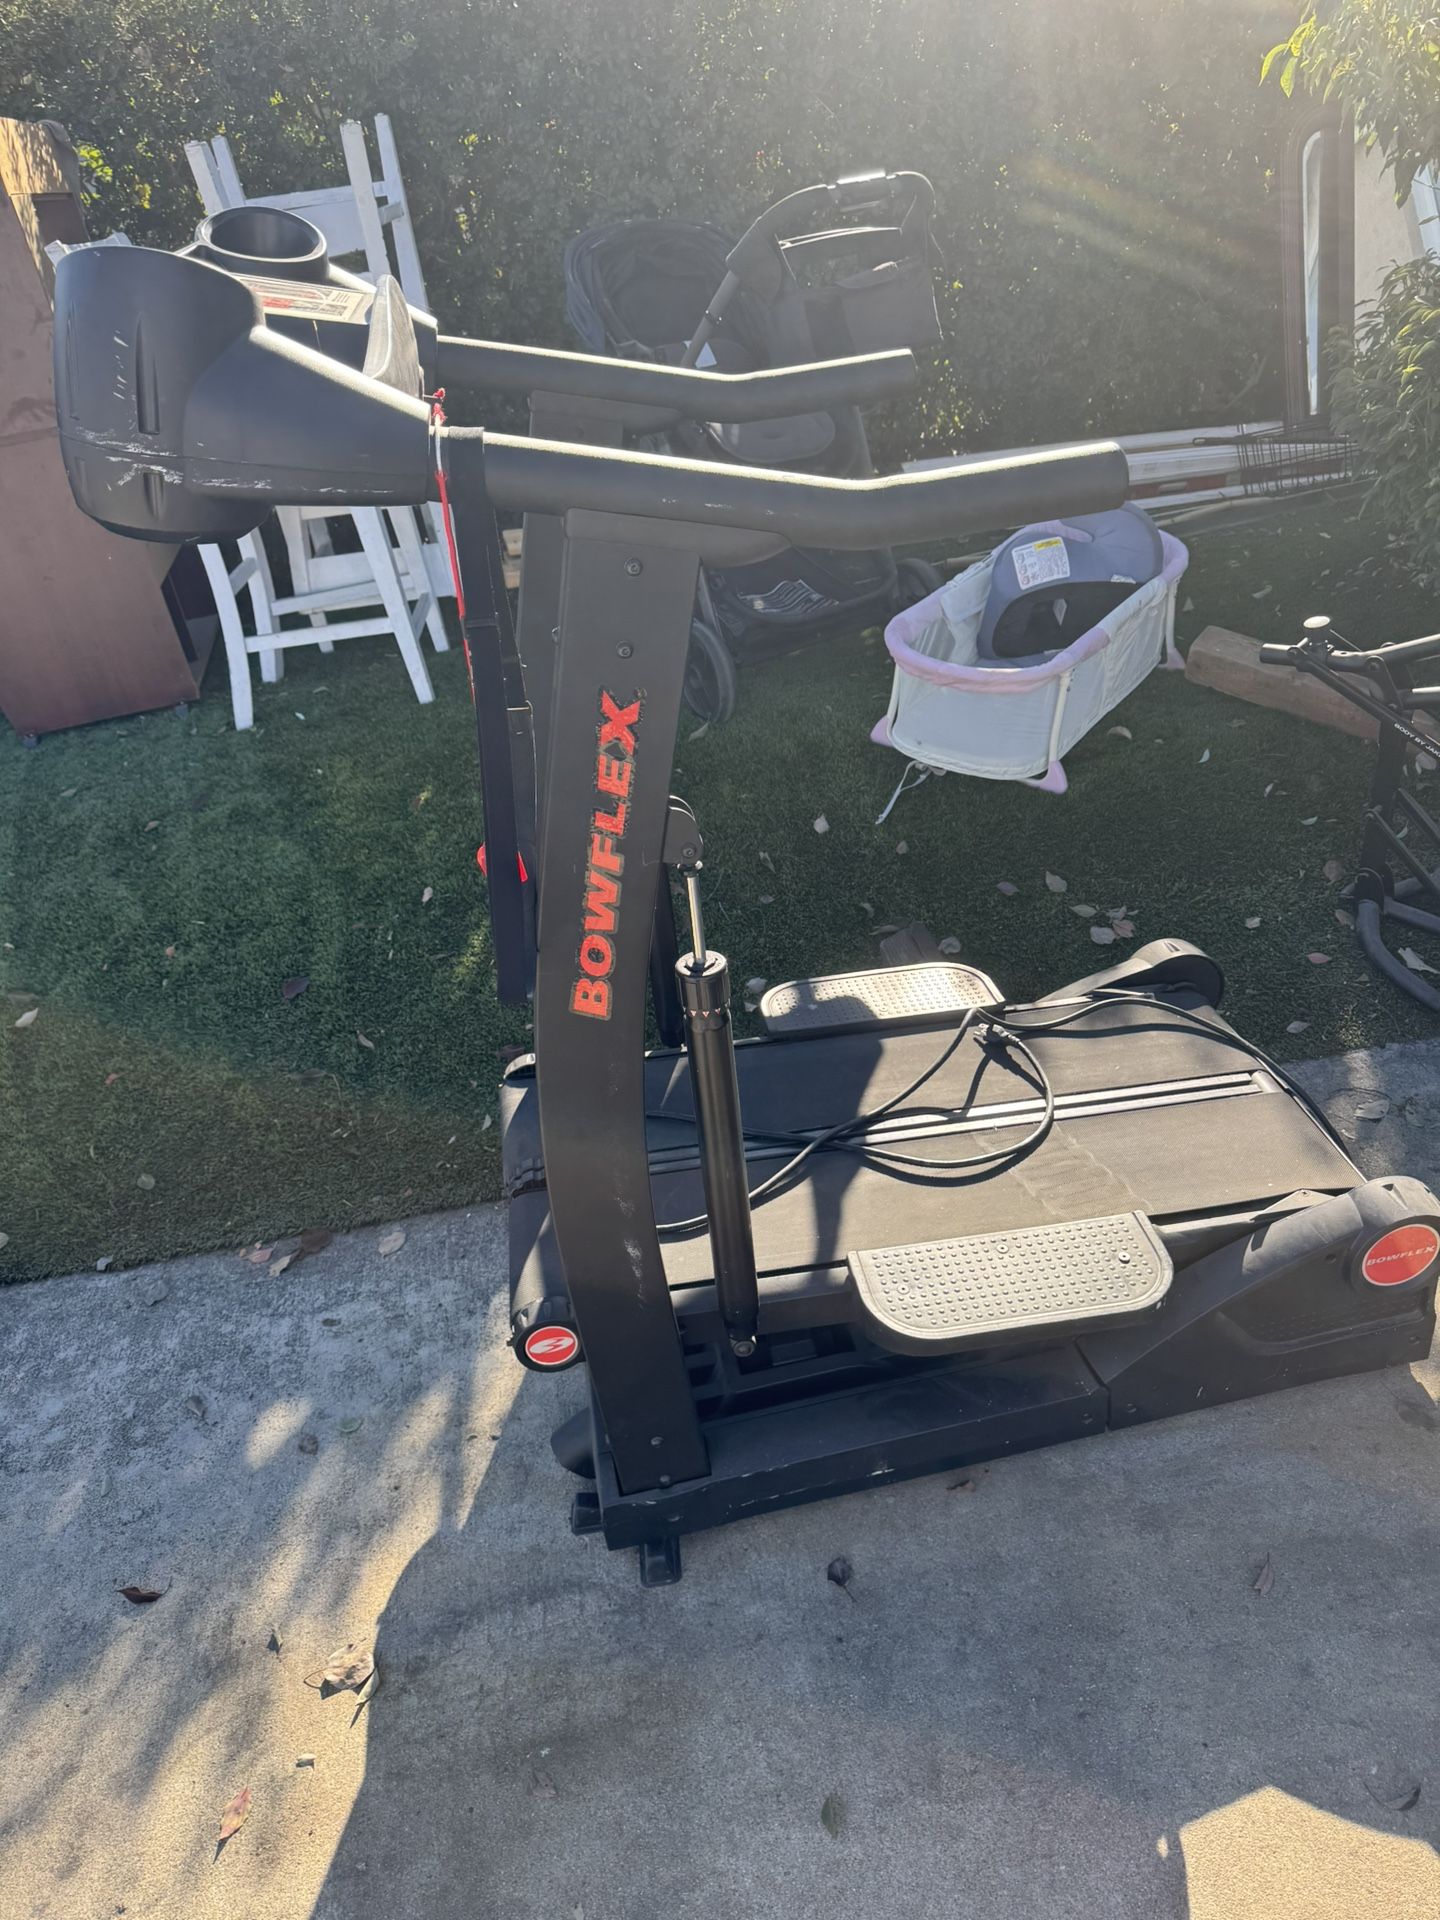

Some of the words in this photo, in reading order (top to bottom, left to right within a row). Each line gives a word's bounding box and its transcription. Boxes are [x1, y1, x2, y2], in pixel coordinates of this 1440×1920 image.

[1394, 723, 1415, 738] BODY
[1415, 737, 1426, 746] BY
[572, 690, 641, 1018] BOWFLEX
[1366, 1245, 1436, 1267] BOWFLEX
